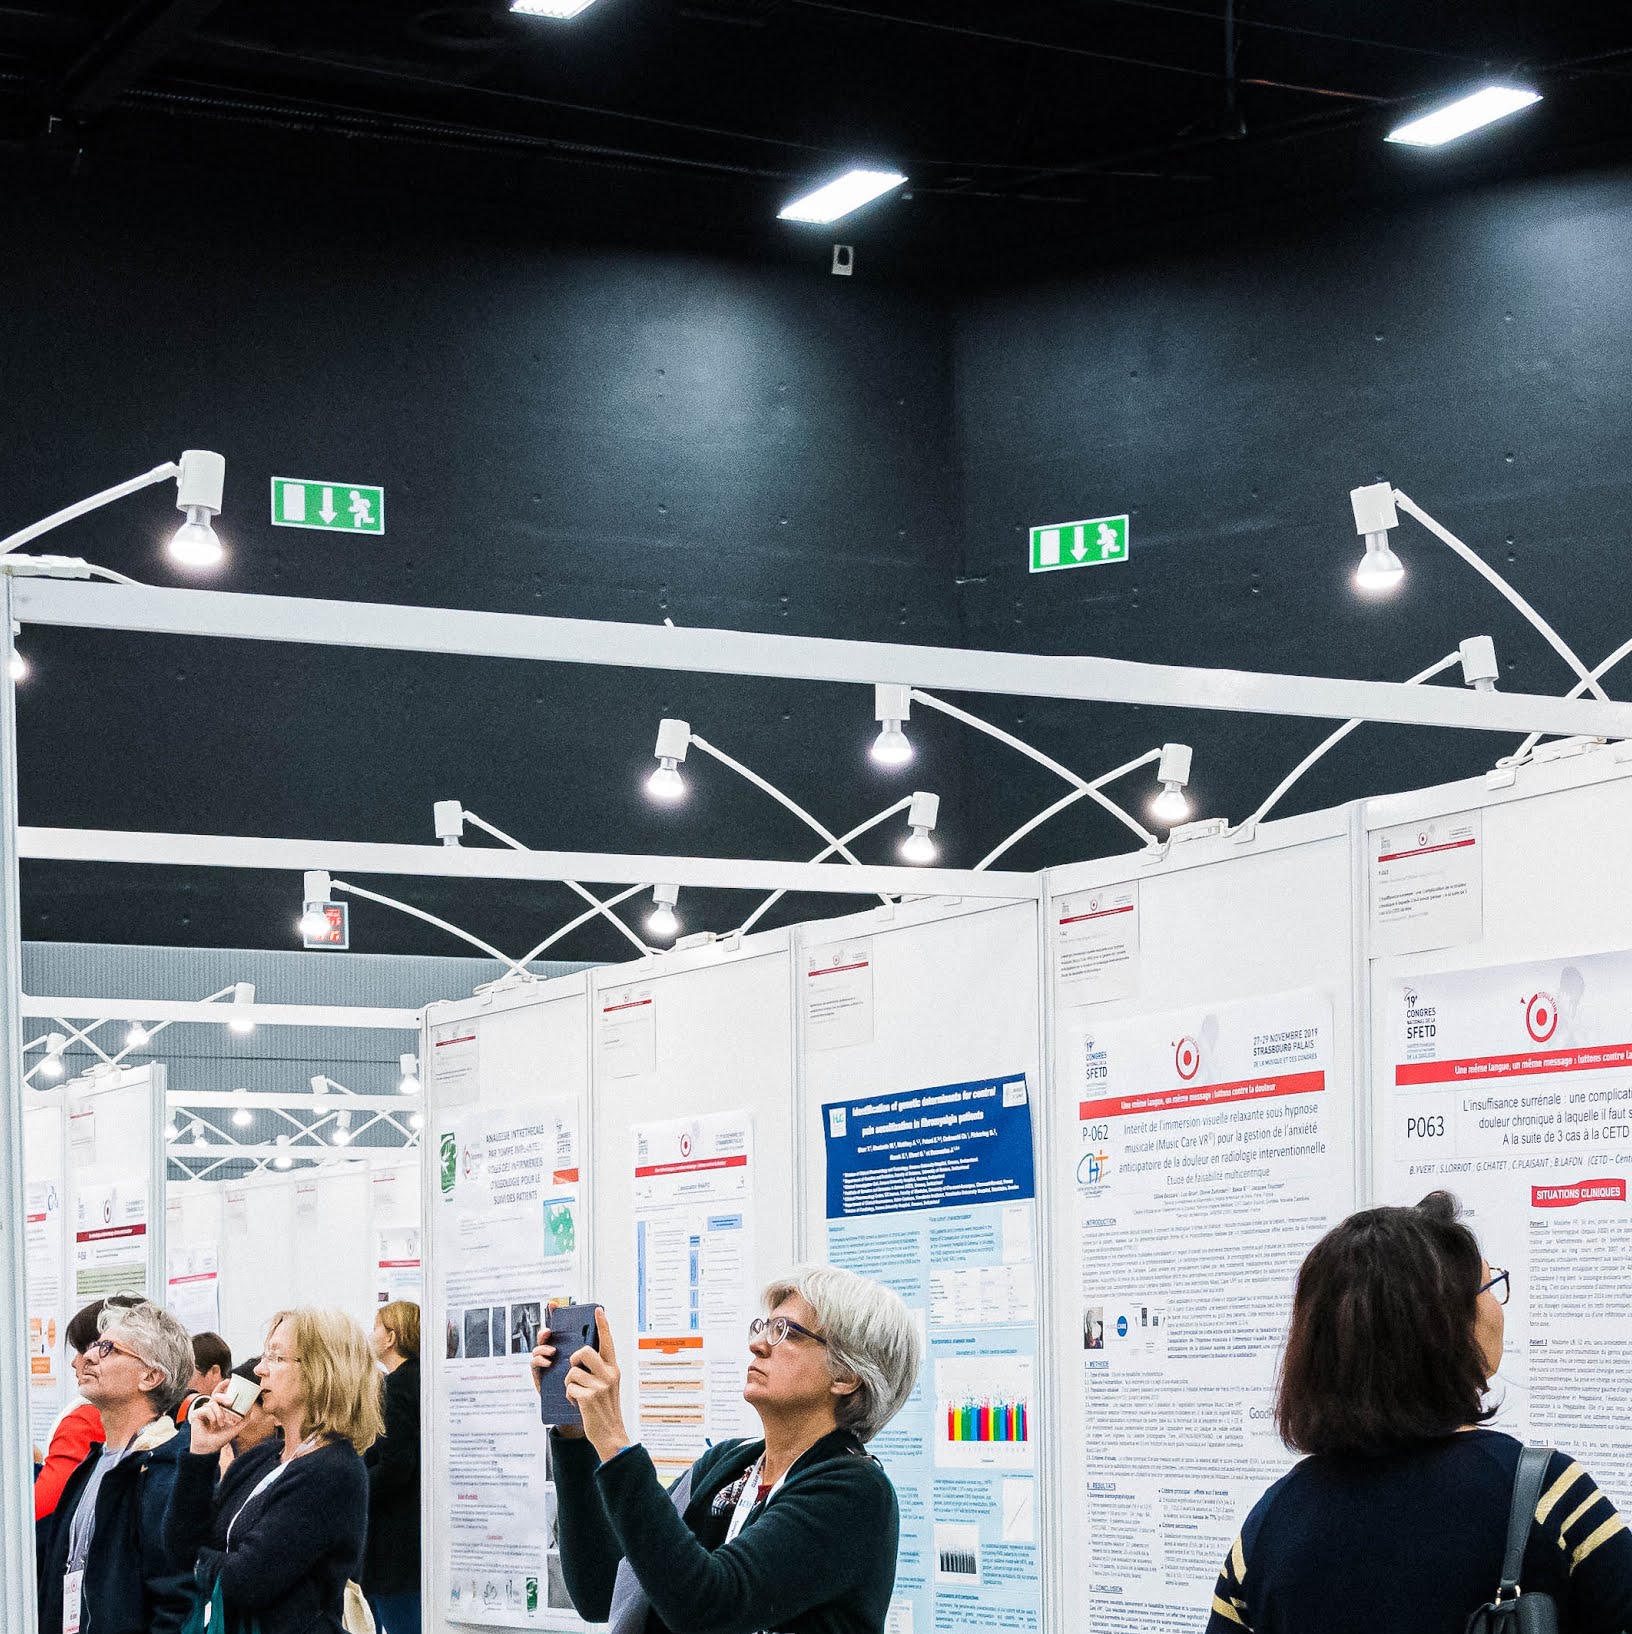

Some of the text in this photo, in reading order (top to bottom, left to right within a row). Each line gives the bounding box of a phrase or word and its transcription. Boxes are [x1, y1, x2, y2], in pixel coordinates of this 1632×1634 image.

[1407, 1025, 1436, 1039] SFETD
[1086, 1067, 1107, 1079] SFETD
[1463, 1097, 1518, 1112] L'insuffisance
[1521, 1093, 1560, 1107] surrénale
[1569, 1093, 1585, 1104] une
[1149, 1122, 1158, 1132] de
[1159, 1116, 1200, 1131] l'immersion
[1203, 1112, 1228, 1125] visuelle
[1230, 1109, 1264, 1122] relaxante
[1266, 1108, 1282, 1119] sous
[1285, 1104, 1318, 1119] hypnose
[1407, 1116, 1444, 1138] P063
[1479, 1114, 1509, 1129] douleur
[1513, 1111, 1554, 1127] chronique
[1556, 1111, 1562, 1123] à
[1565, 1110, 1599, 1124] laquelle
[1601, 1109, 1606, 1120] il
[1609, 1107, 1626, 1119] faut
[1083, 1124, 1108, 1141] P-062
[1125, 1141, 1154, 1154] musicale
[1156, 1139, 1178, 1152] (Music
[1181, 1136, 1197, 1149] Care
[1218, 1132, 1234, 1145] pour
[1236, 1130, 1242, 1140] la
[1244, 1127, 1270, 1143] gestion
[1273, 1126, 1282, 1138] de
[1284, 1122, 1317, 1135] l'anxiété
[1503, 1135, 1509, 1145] A
[1512, 1134, 1518, 1144] la
[1522, 1132, 1541, 1144] suite
[1544, 1131, 1555, 1142] de
[1558, 1130, 1563, 1142] 3
[1566, 1131, 1581, 1141] cas
[1584, 1128, 1589, 1140] à
[1591, 1128, 1599, 1140] la
[1602, 1125, 1629, 1139] CETD
[1119, 1142, 1326, 1173] anticipatoire de la douleur en radiologie interventionnelle
[1536, 1186, 1621, 1201] SITUATIONS CLINIQUES
